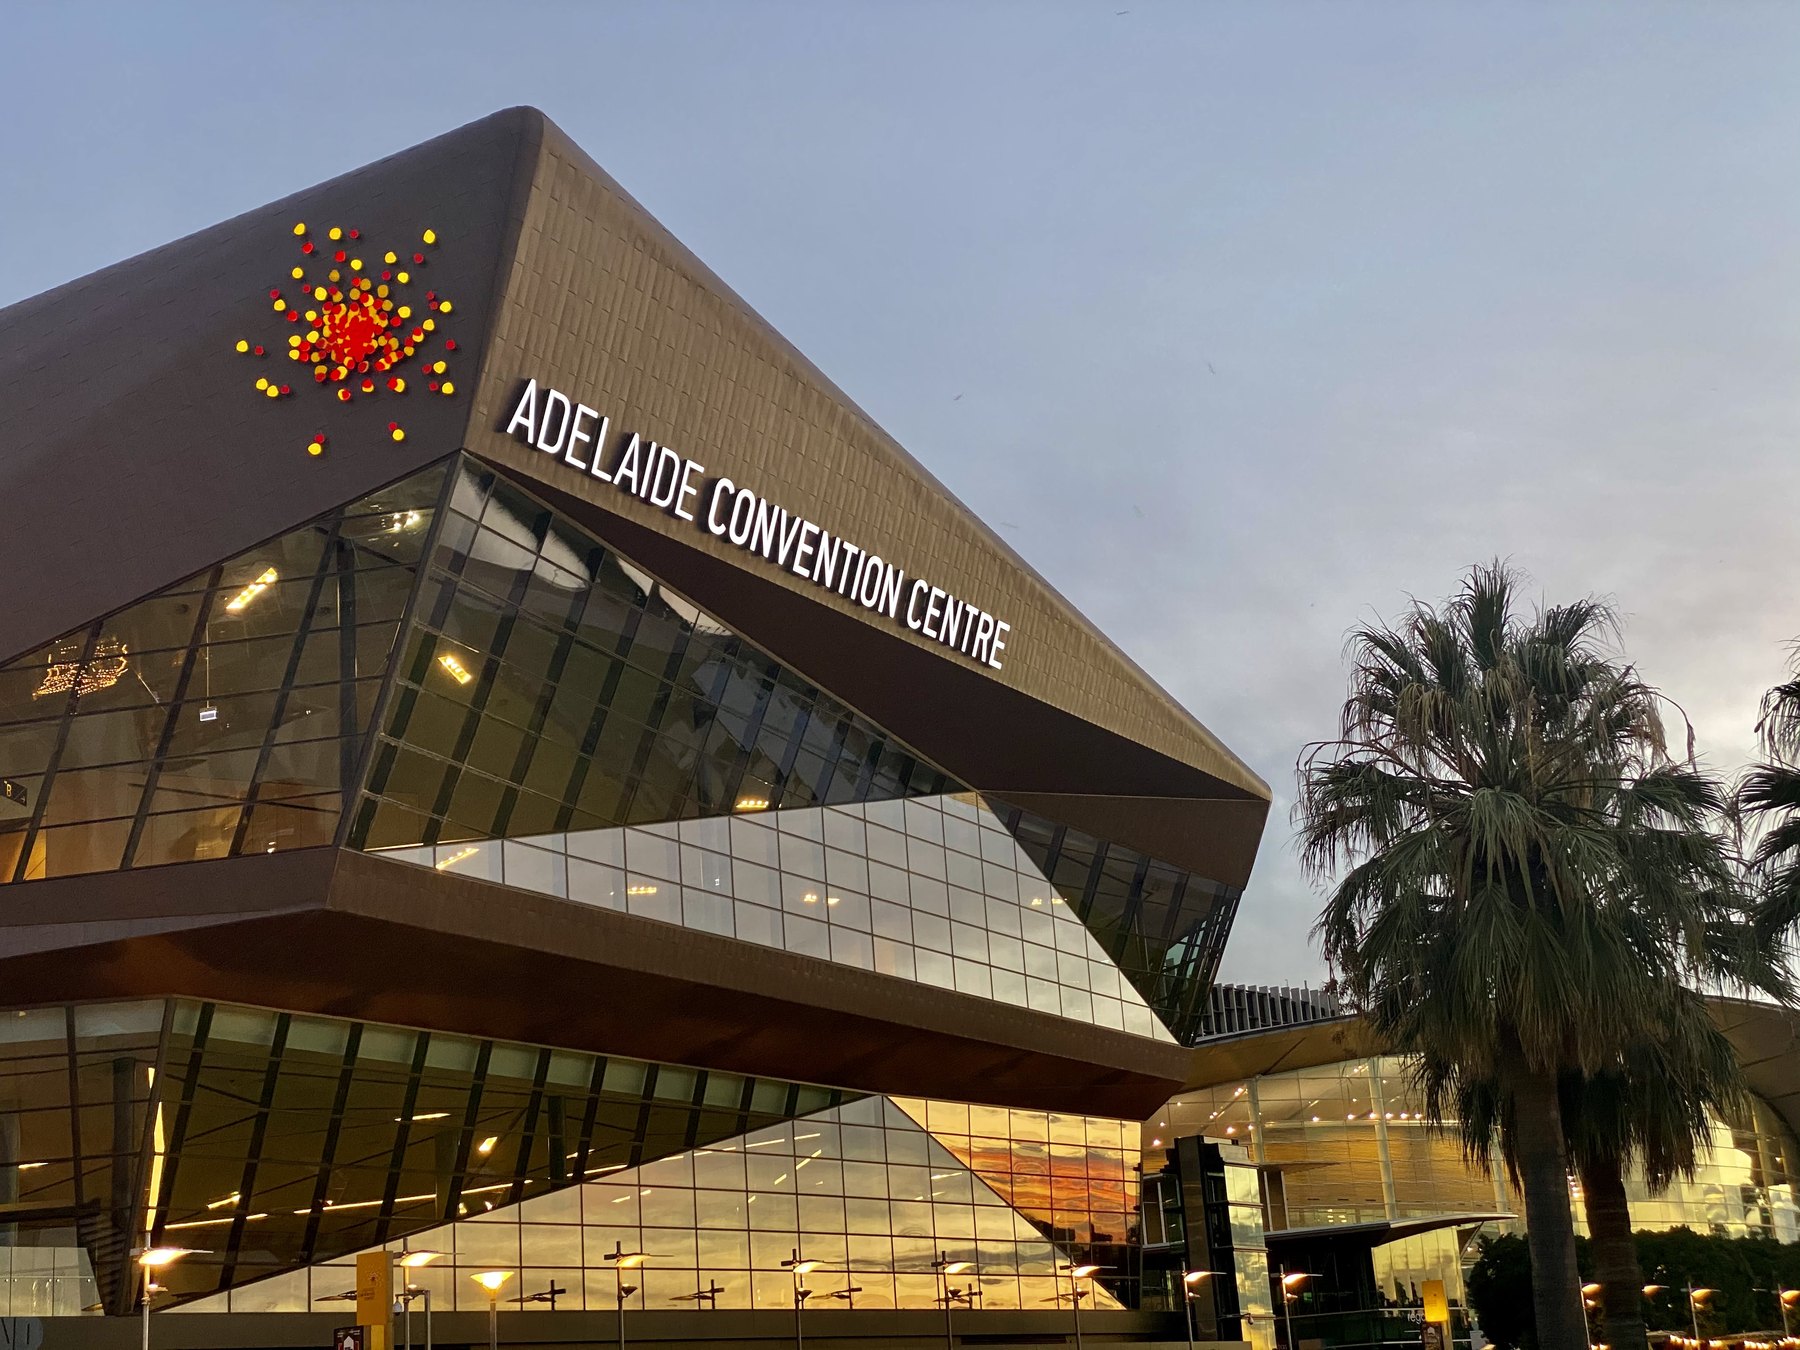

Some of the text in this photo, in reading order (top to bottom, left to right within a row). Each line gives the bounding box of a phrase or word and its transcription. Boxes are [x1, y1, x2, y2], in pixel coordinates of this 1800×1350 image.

[506, 378, 1011, 670] ADELAIDE CONVENTION CENTRE
